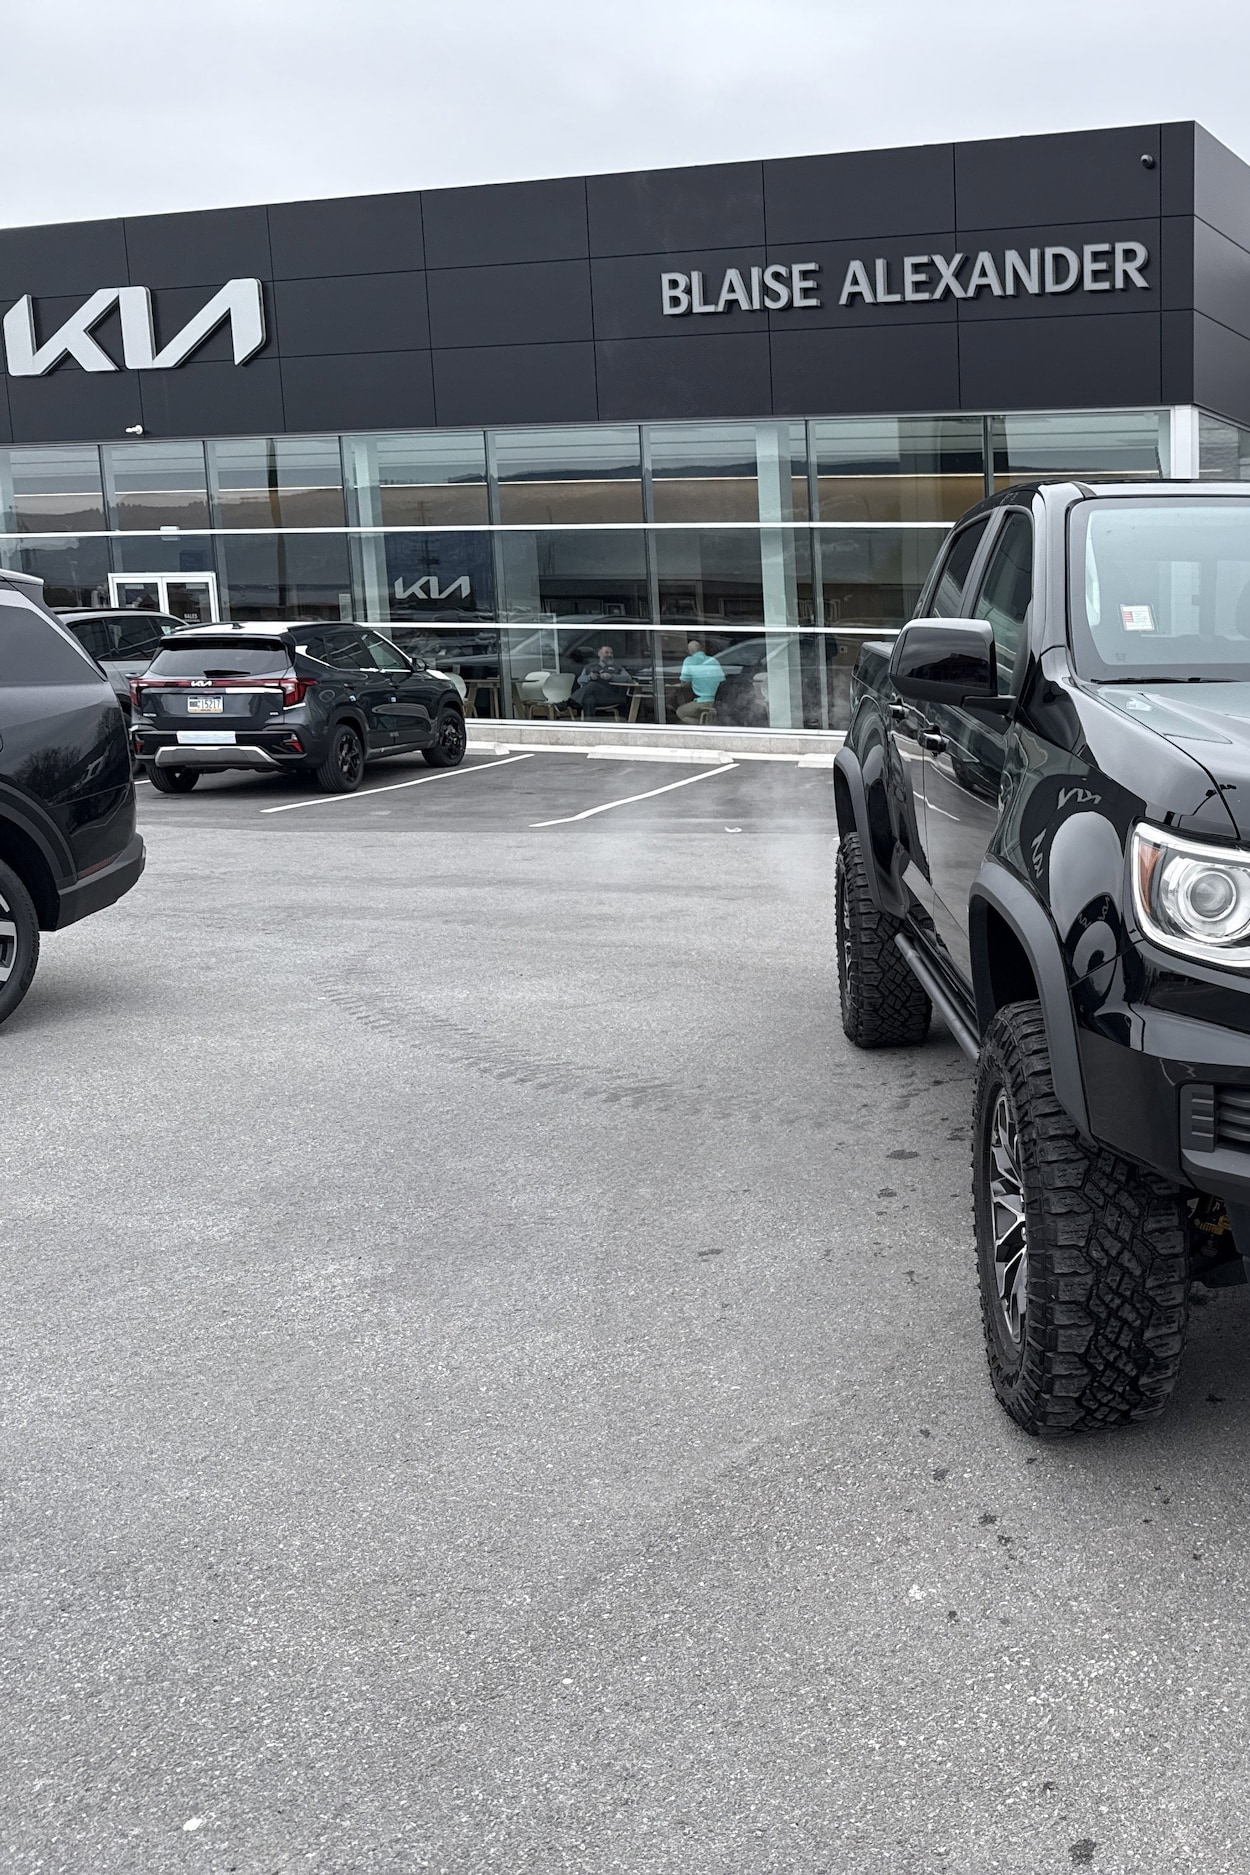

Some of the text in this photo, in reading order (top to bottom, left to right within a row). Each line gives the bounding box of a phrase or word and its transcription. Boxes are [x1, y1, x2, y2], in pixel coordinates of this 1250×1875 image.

[661, 241, 1149, 315] BLAISE ALEXANDER
[3, 278, 266, 377] KIA
[394, 575, 471, 599] KIA
